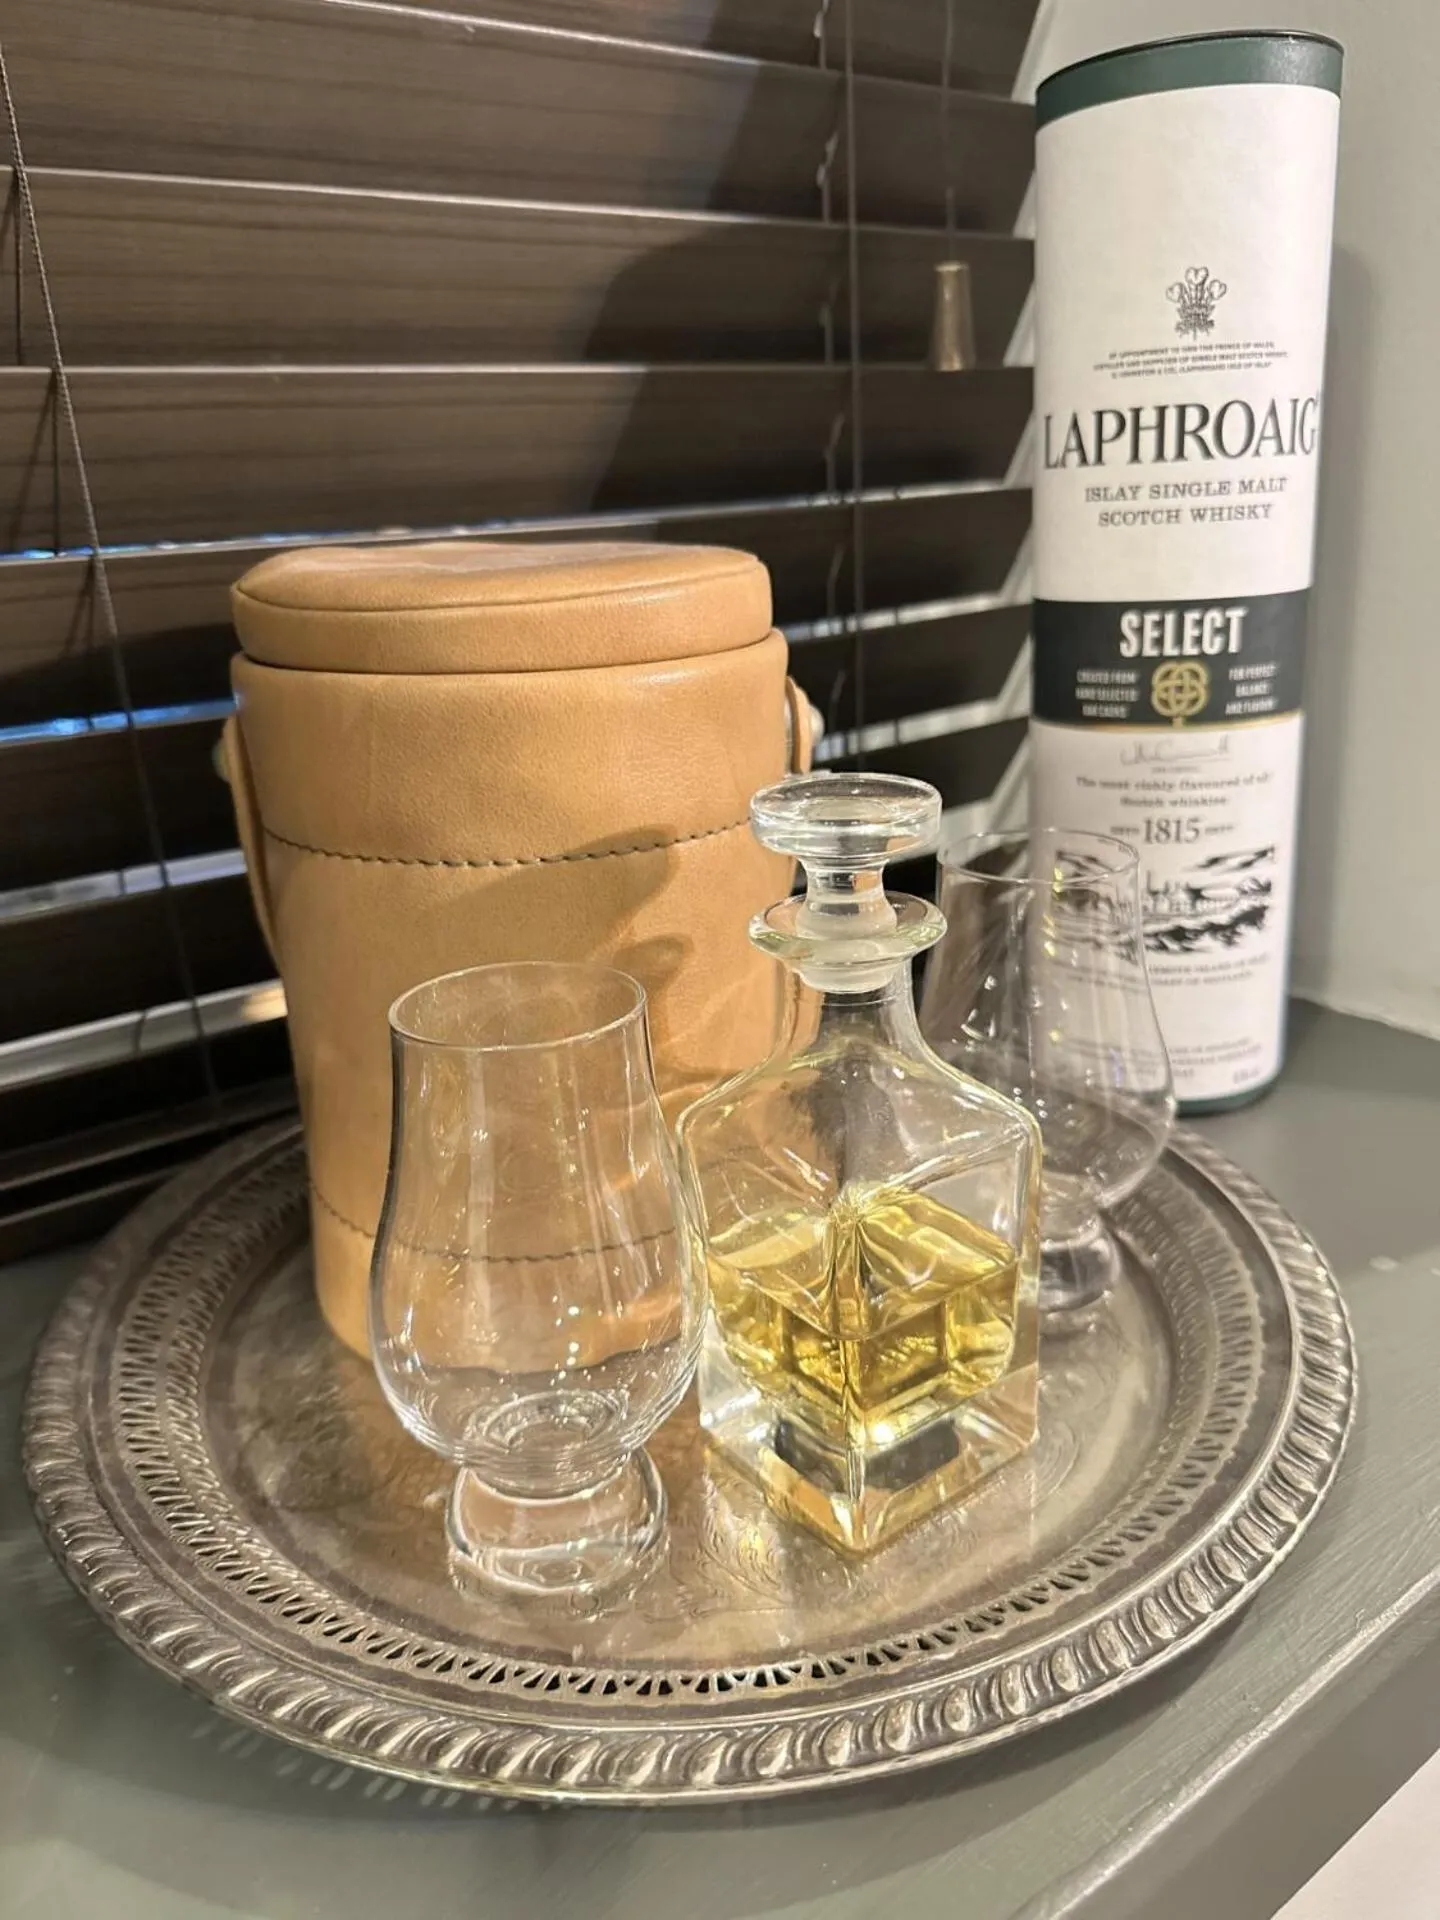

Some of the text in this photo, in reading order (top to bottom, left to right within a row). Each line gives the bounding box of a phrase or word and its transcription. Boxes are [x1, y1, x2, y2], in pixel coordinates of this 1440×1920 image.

[1043, 396, 1319, 470] LAPHROAIG
[1085, 476, 1288, 503] ISLAY SINGLE MALT
[1098, 503, 1273, 528] SCOTCH WHISKY
[1119, 606, 1247, 659] SELECT
[1143, 815, 1203, 846] 1815
